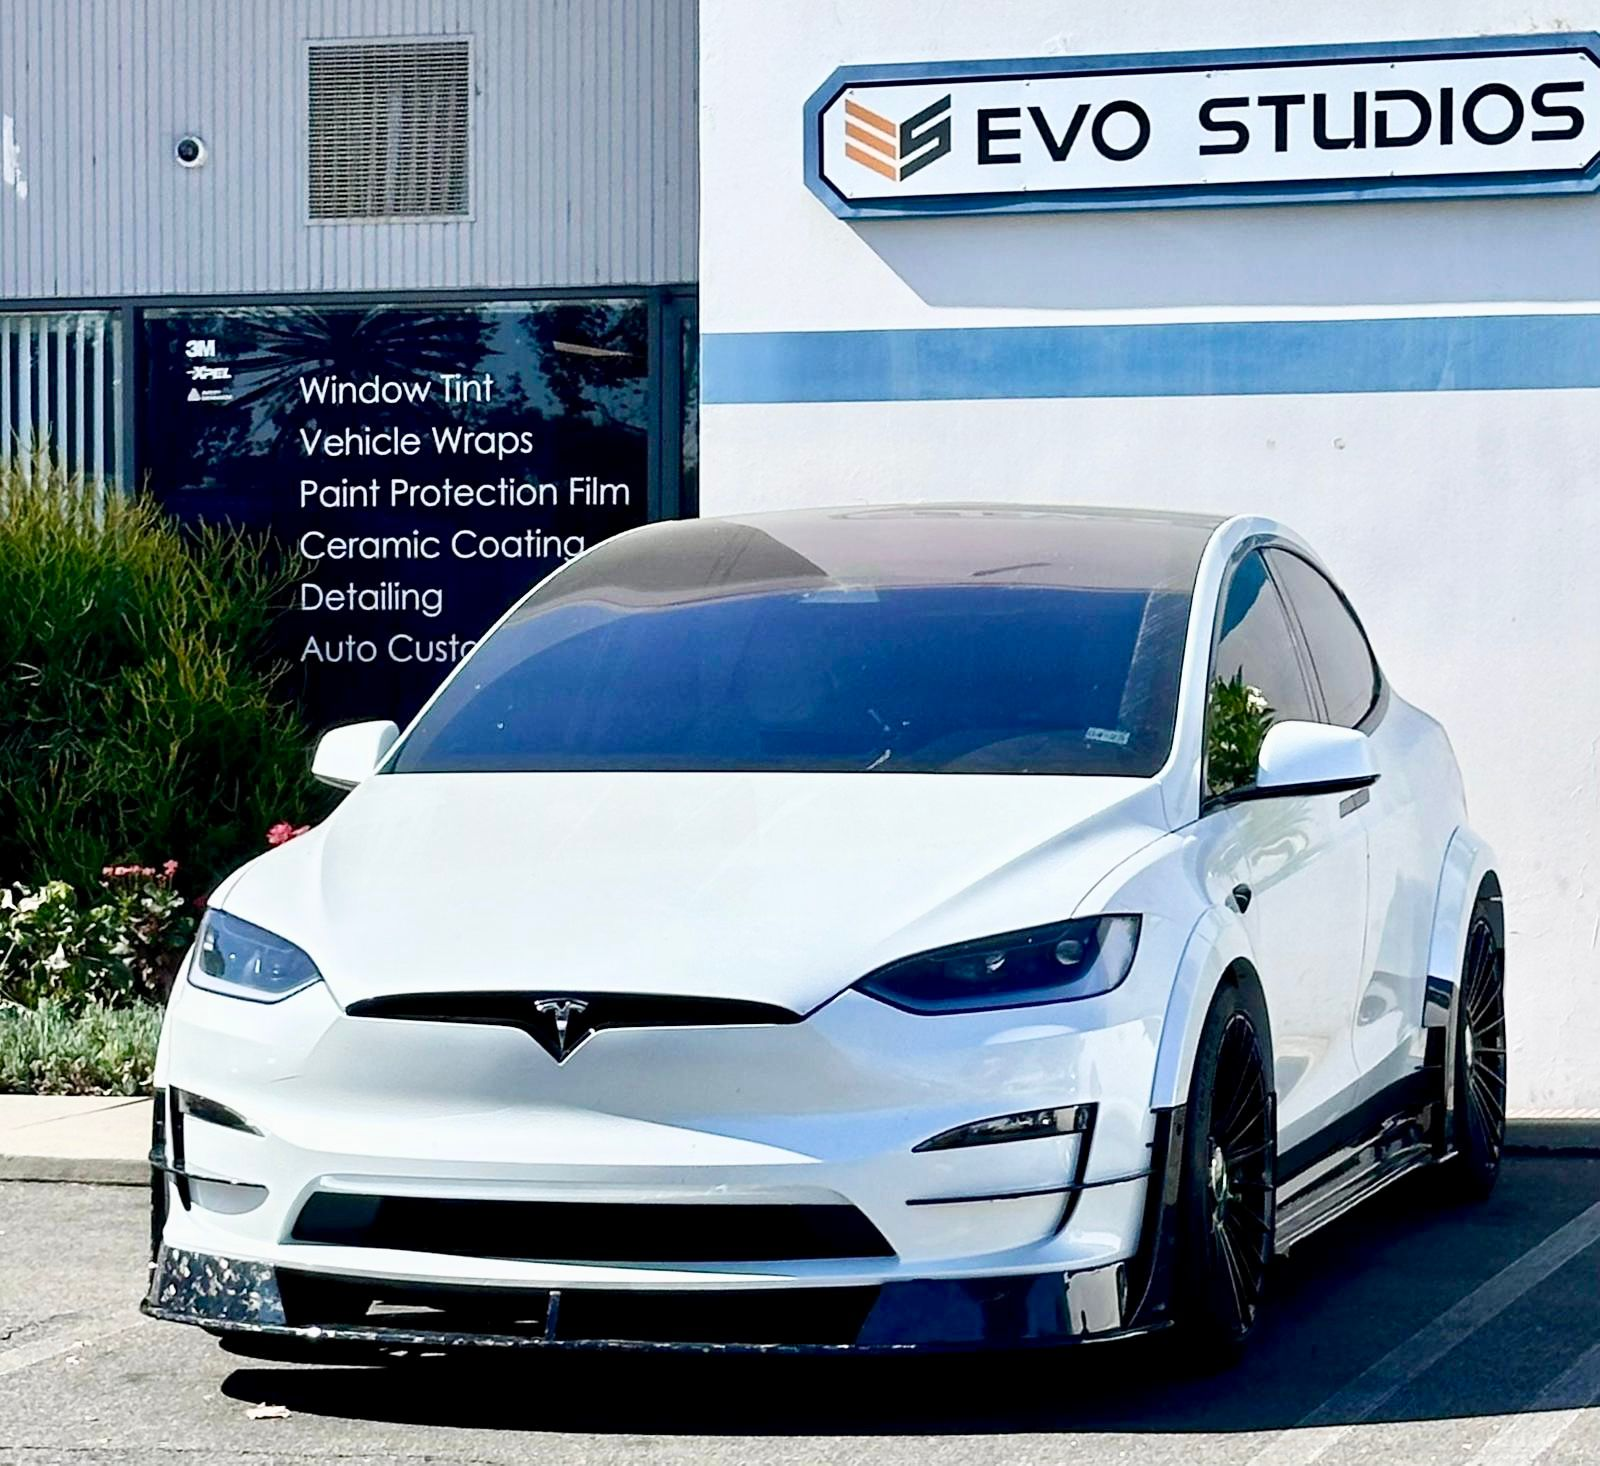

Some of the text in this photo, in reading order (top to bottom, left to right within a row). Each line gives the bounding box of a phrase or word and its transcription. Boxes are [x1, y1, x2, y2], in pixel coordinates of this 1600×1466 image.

[977, 99, 1151, 166] EVO
[1199, 82, 1586, 156] STUDIOS
[185, 339, 216, 358] 3M
[301, 374, 494, 405] Window Tint
[300, 427, 534, 460] Vehicle Wraps
[301, 477, 631, 509] Paint Protection Film
[301, 529, 585, 561] Ceramic Coating
[302, 583, 443, 618] Detailing
[301, 635, 378, 663] Auto
